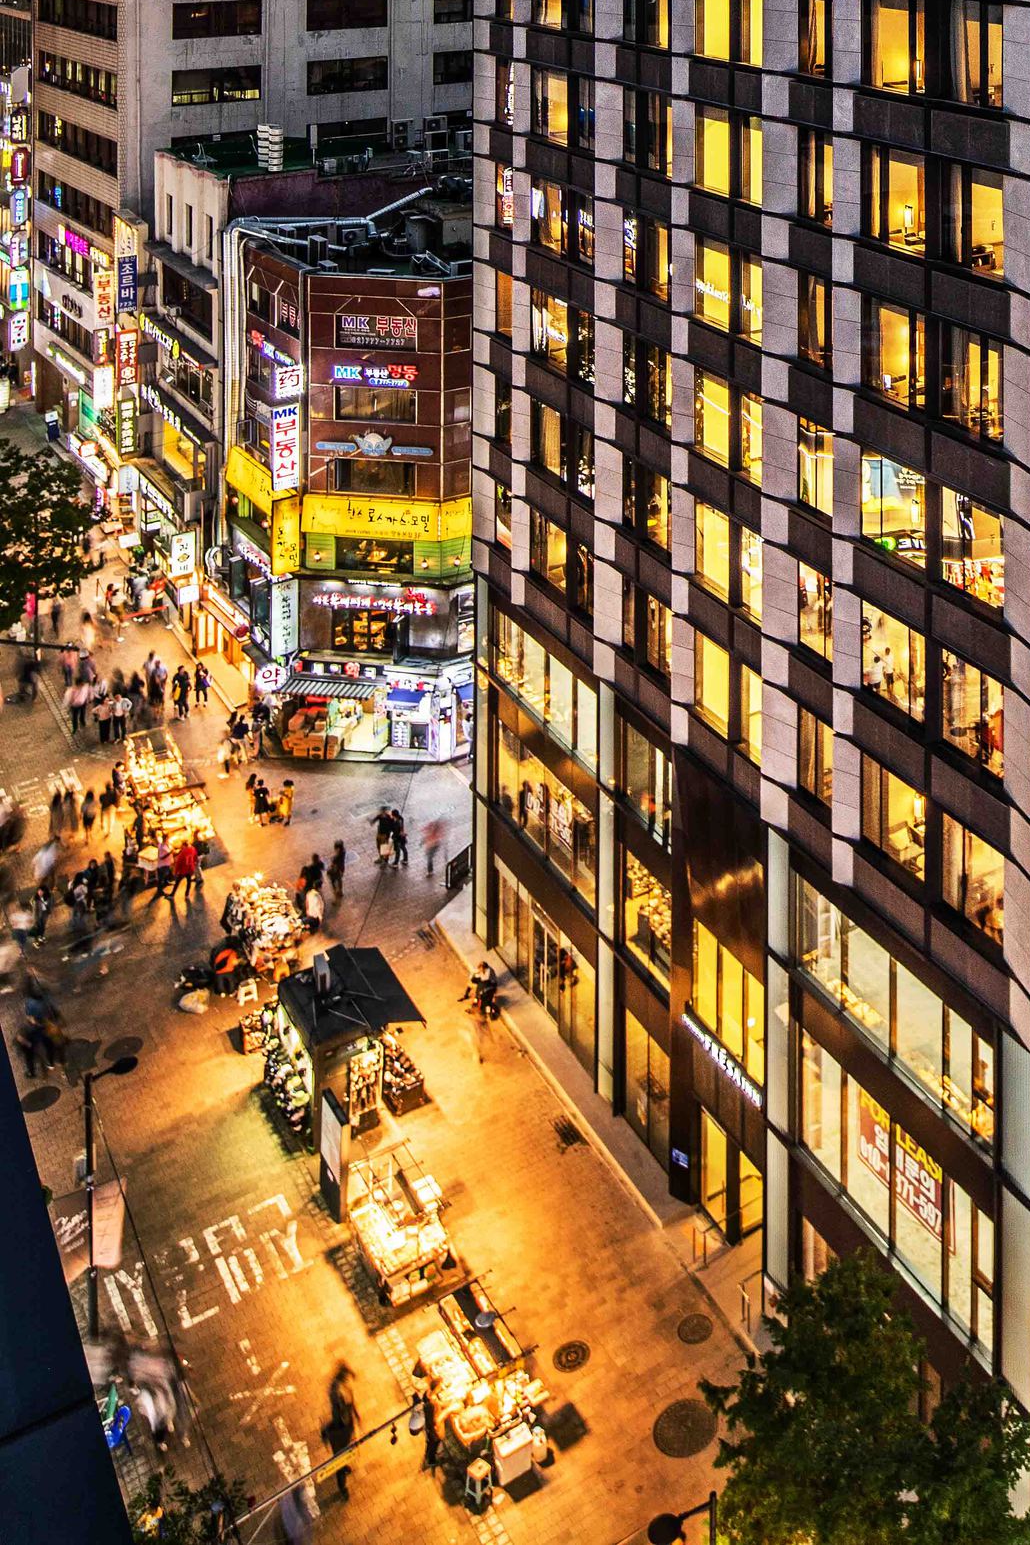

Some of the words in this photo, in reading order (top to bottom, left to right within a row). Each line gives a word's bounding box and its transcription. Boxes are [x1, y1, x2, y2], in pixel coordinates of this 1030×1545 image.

[120, 263, 136, 300] 조르바
[97, 279, 112, 319] 부동산
[341, 316, 370, 328] MK
[375, 316, 417, 337] 부동산
[278, 368, 301, 390] 药
[333, 365, 363, 379] MK
[364, 366, 388, 378] 부동산
[387, 364, 419, 381] 명동
[275, 406, 298, 420] MK
[275, 420, 298, 478] 부동산
[261, 667, 281, 686] 약
